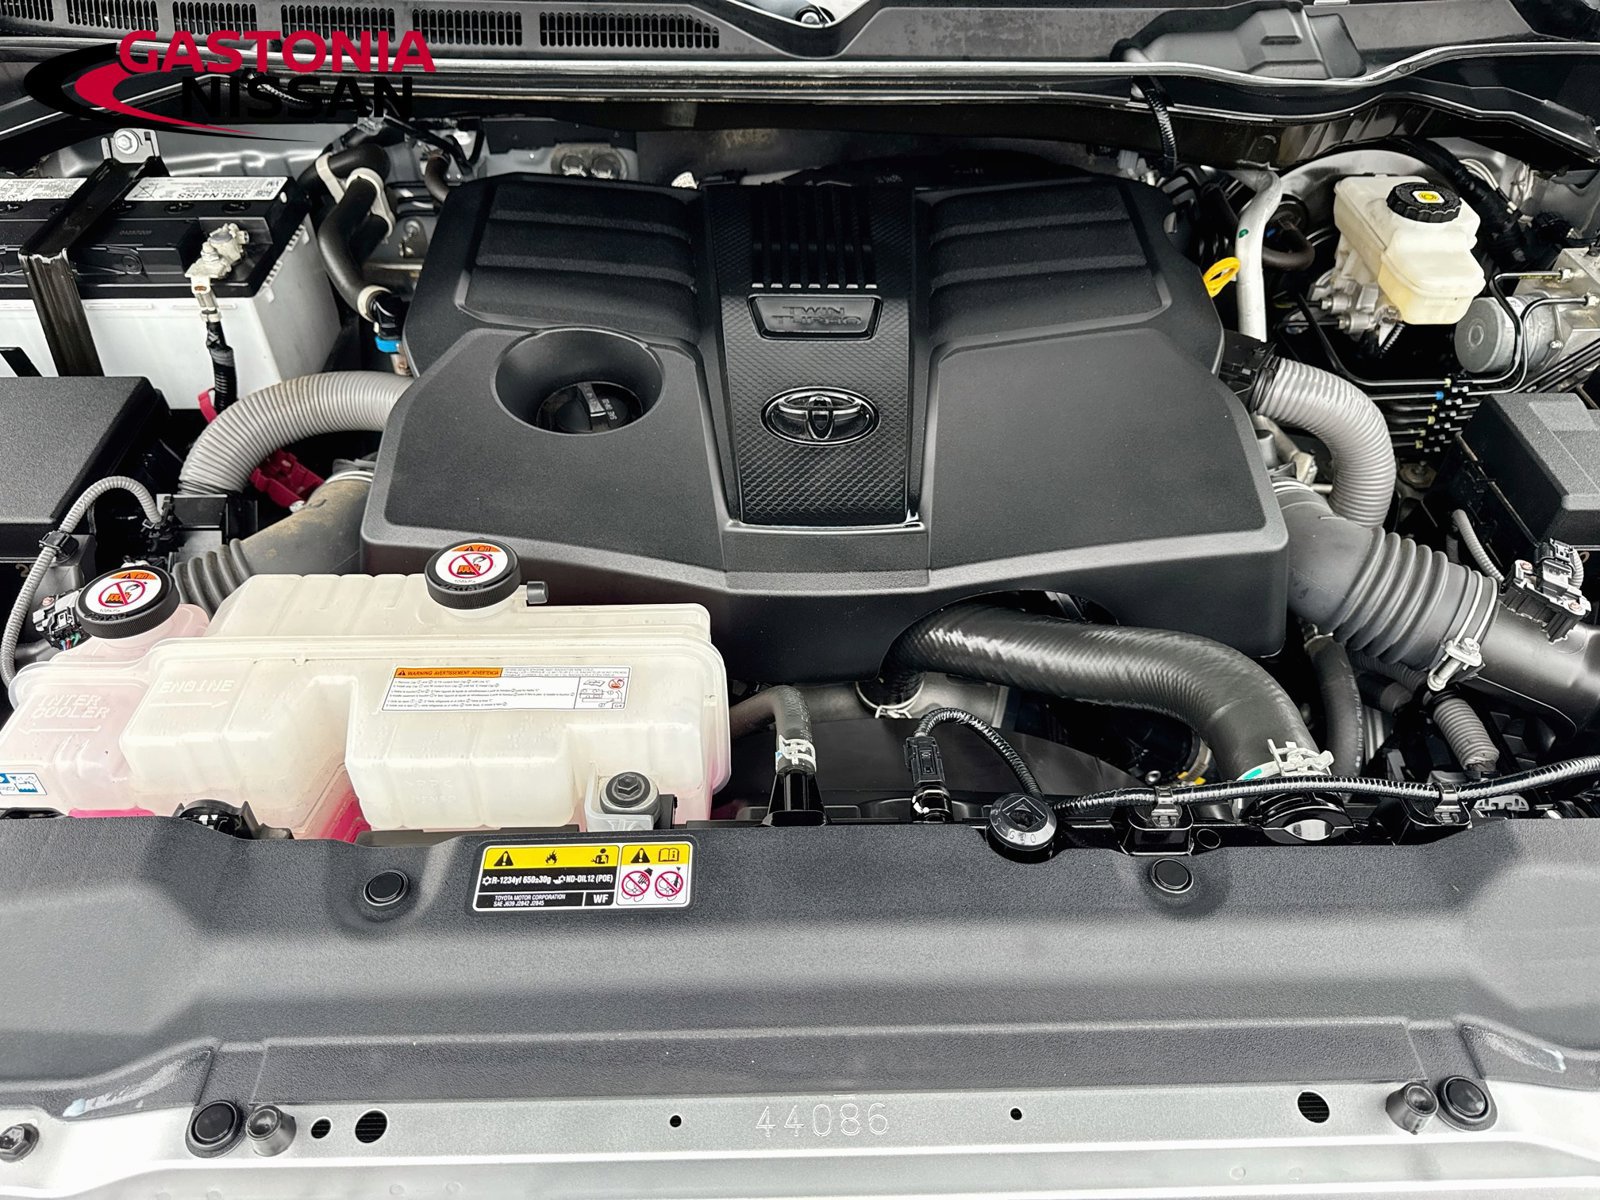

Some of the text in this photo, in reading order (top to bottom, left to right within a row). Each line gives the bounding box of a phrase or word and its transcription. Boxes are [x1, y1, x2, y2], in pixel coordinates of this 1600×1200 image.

[782, 306, 845, 315] TWIN
[772, 315, 862, 325] TURBO
[159, 679, 236, 694] ENGINE
[38, 694, 102, 707] INTER
[31, 706, 111, 720] COOLER
[491, 876, 522, 886] R-1234yf
[523, 875, 552, 885] 650±30g
[595, 873, 614, 884] (POE)
[592, 894, 610, 904] WF
[755, 1102, 890, 1138] 44086
